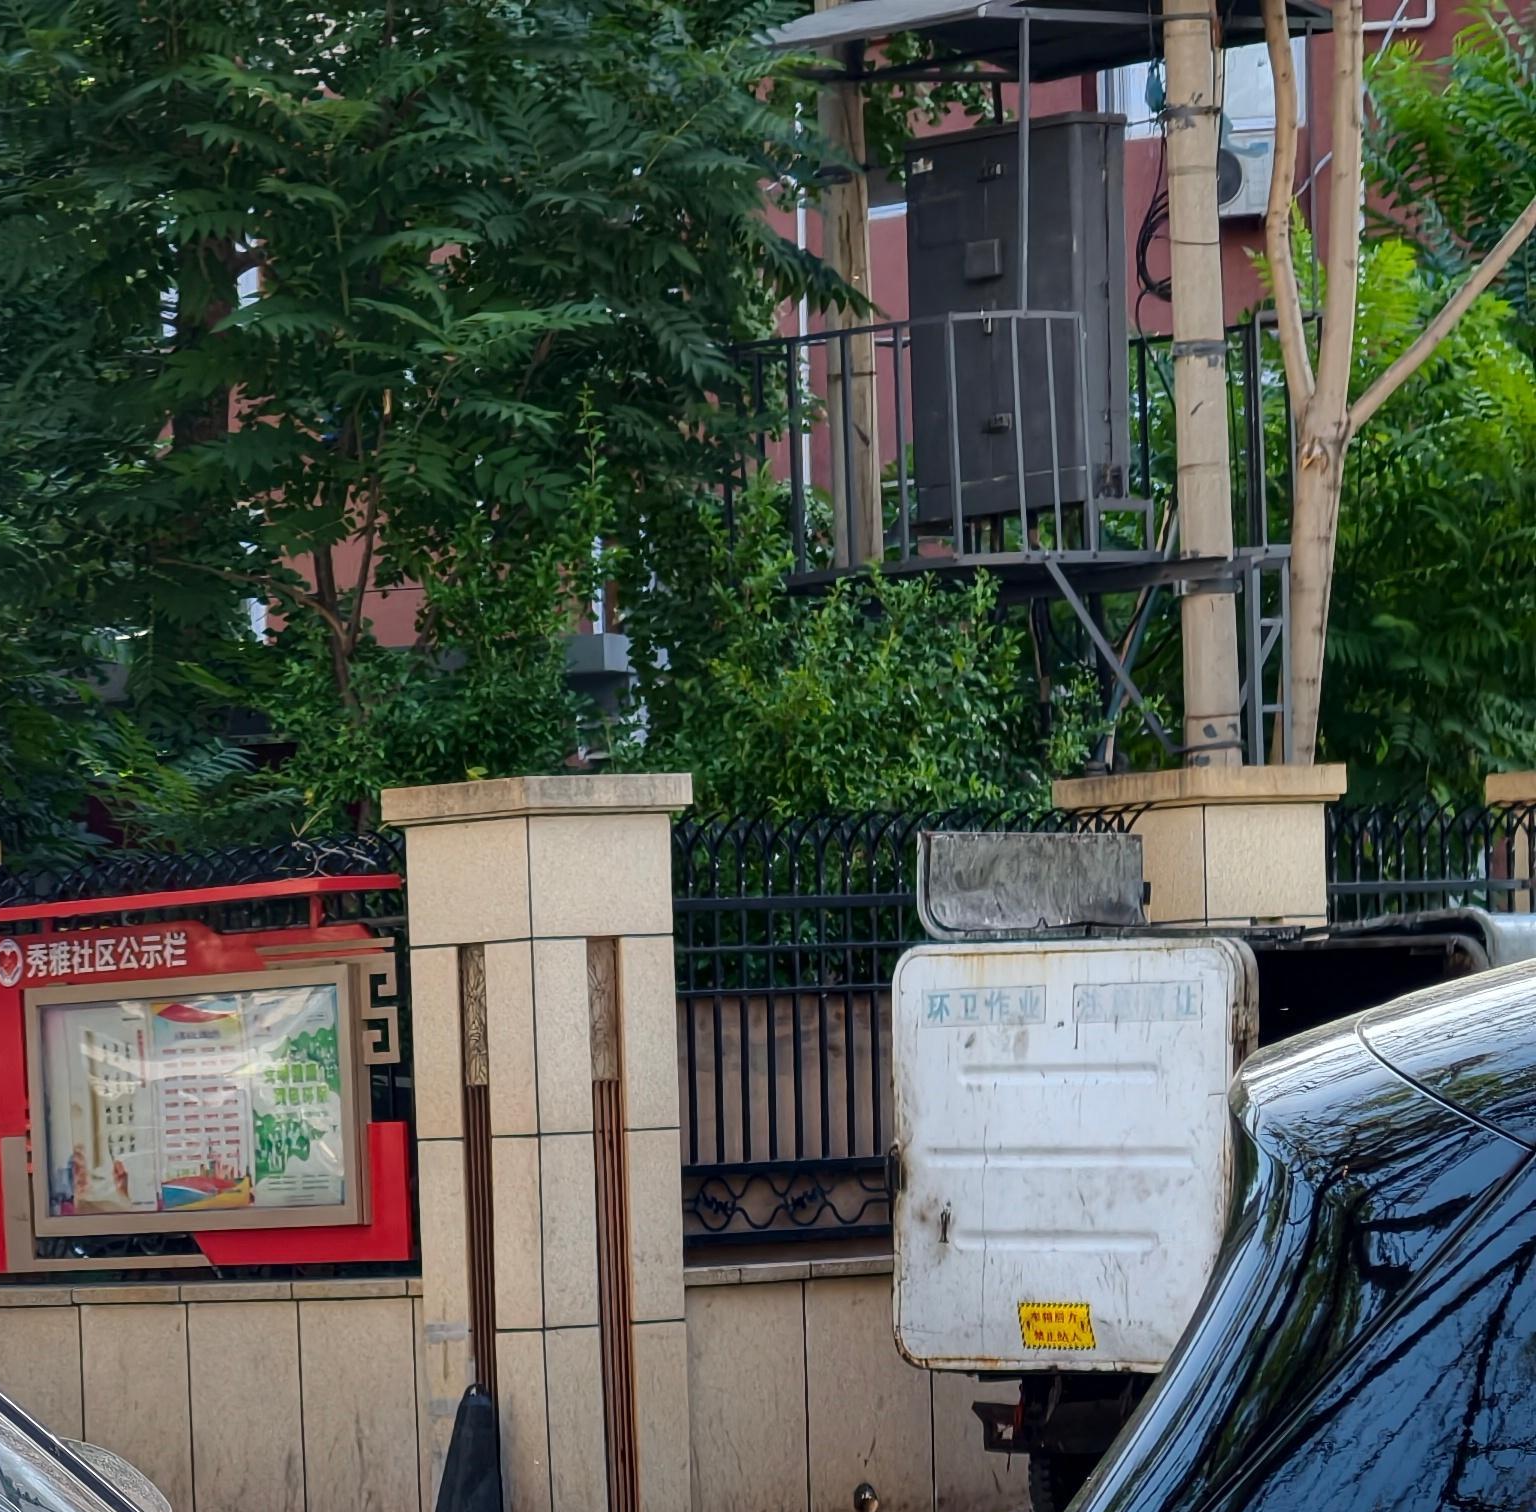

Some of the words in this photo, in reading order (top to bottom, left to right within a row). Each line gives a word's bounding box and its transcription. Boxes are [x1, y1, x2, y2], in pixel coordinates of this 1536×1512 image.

[26, 931, 187, 978] 秀雅社区公示栏
[927, 990, 1041, 1023] 环卫作业
